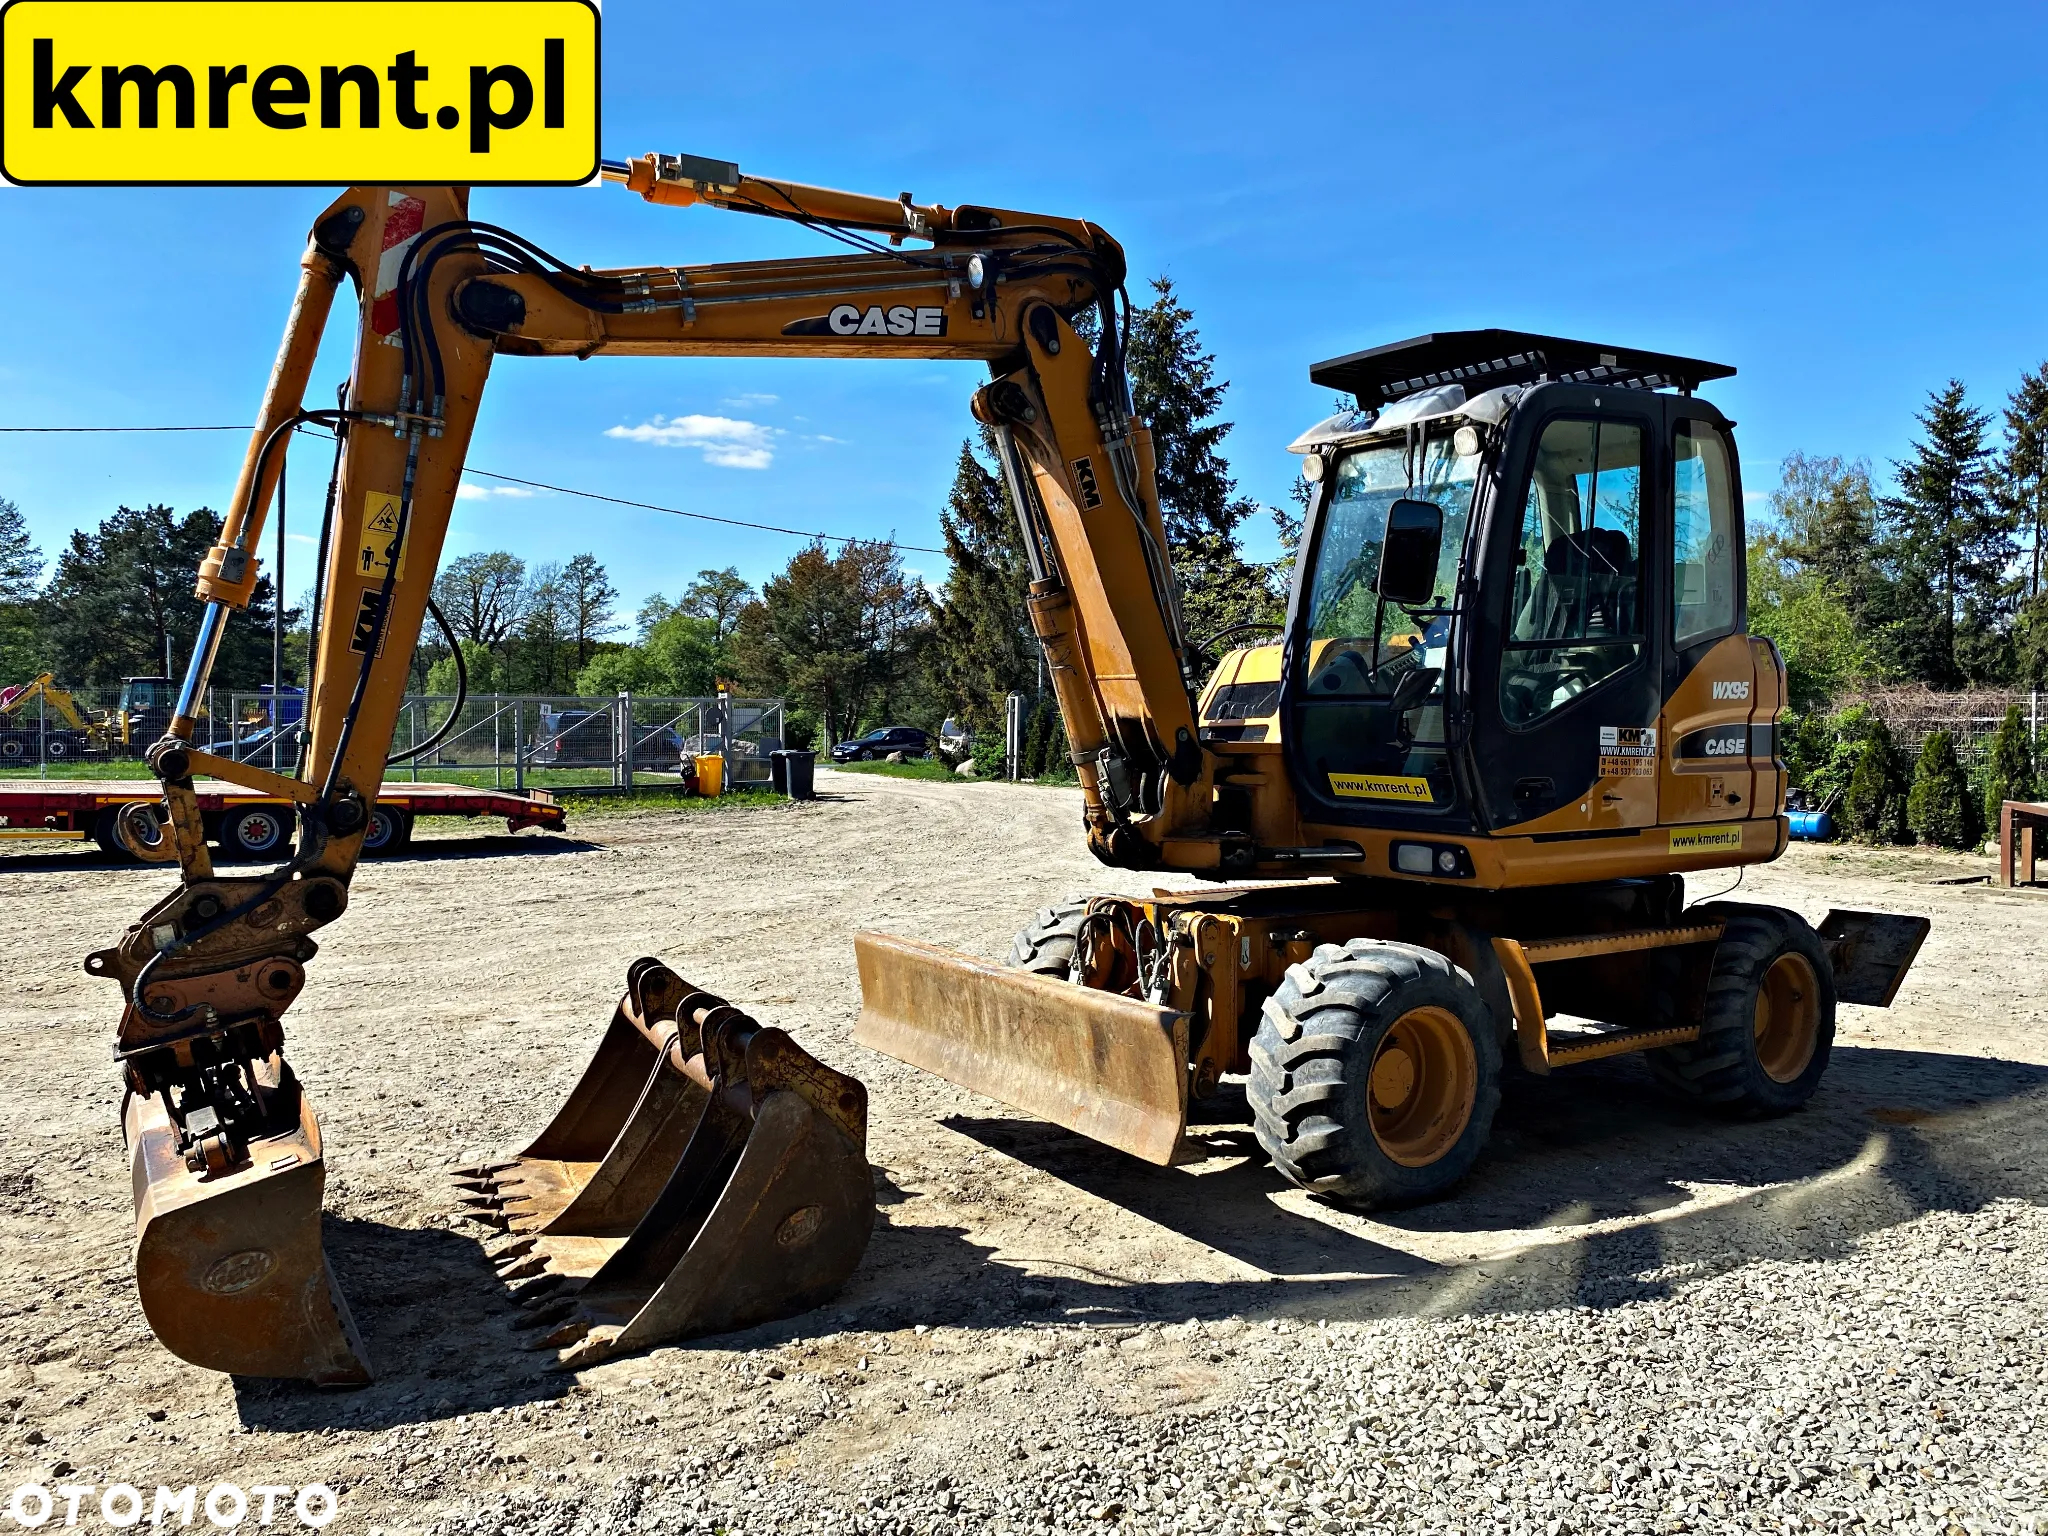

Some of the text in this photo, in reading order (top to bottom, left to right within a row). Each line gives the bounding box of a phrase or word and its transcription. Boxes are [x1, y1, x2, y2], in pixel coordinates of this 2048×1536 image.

[829, 305, 942, 336] CASE
[1076, 458, 1102, 508] KM
[1712, 682, 1750, 700] WX95
[1618, 729, 1641, 742] KM
[1705, 739, 1746, 755] CASE
[1334, 780, 1428, 798] www.kmrent.pl
[1672, 831, 1740, 847] www.kmrent.pl
